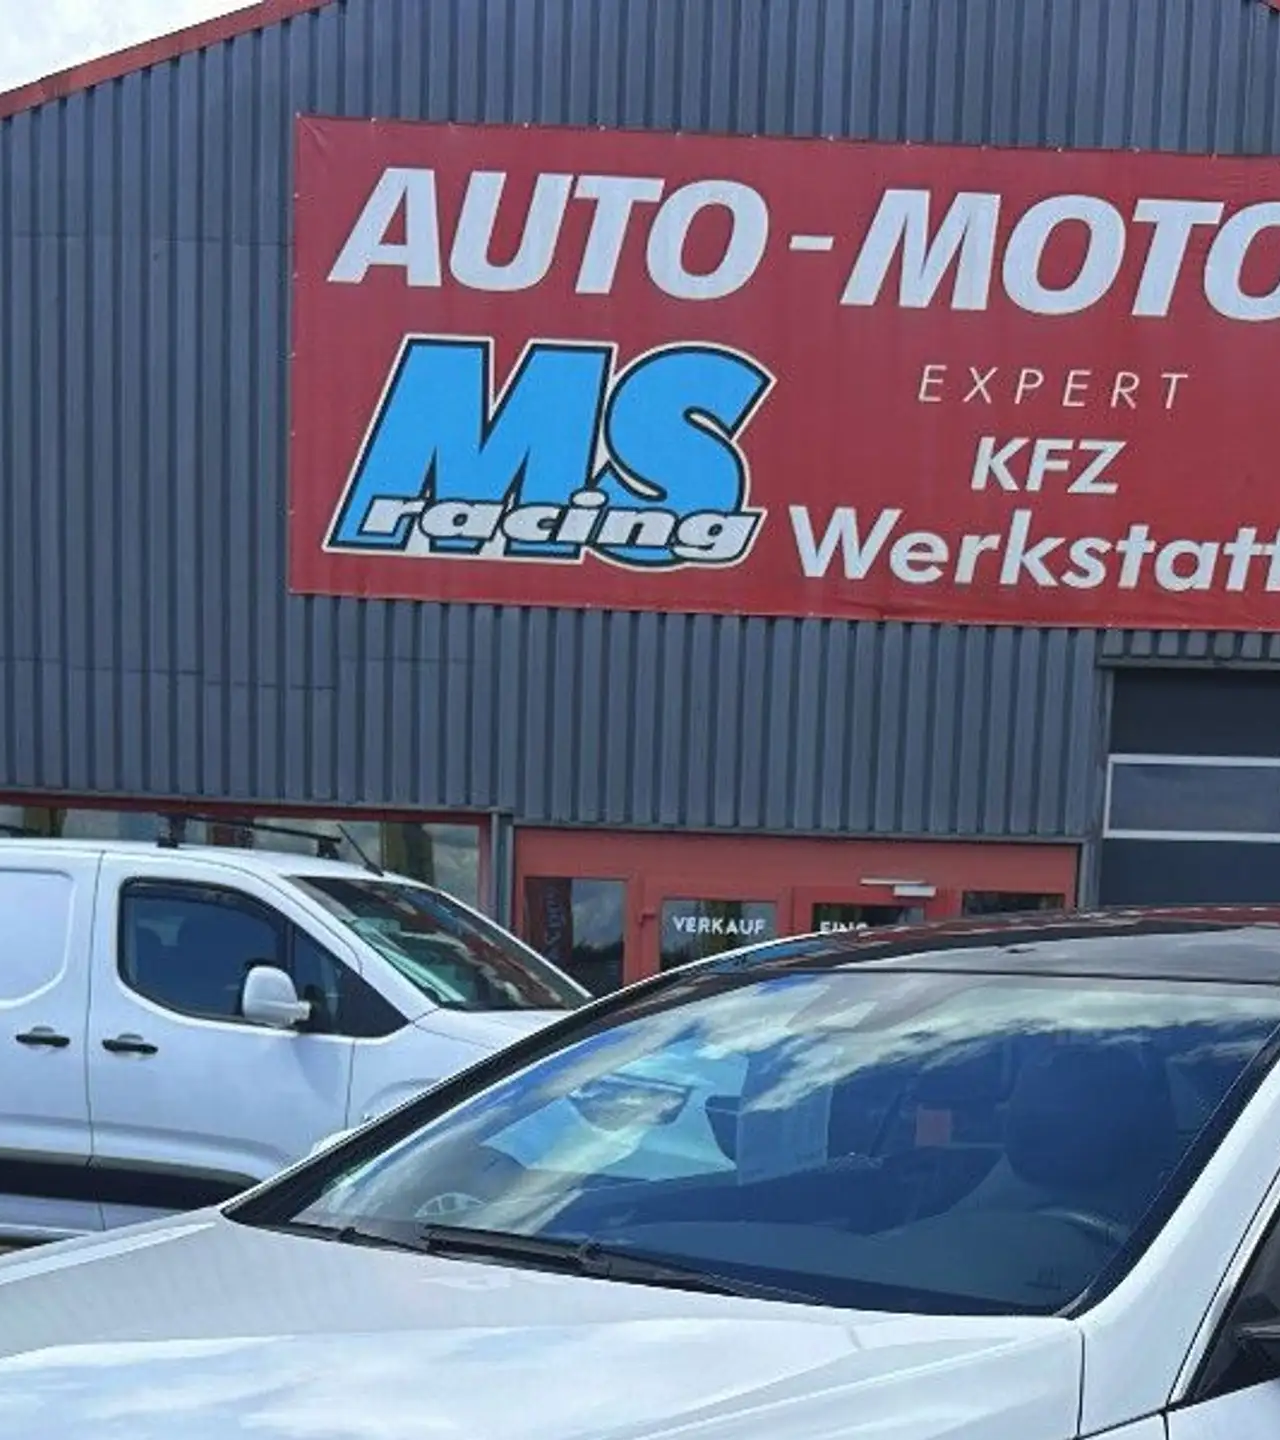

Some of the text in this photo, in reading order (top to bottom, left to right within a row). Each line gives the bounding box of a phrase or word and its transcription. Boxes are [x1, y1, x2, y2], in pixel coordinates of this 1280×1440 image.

[917, 363, 1191, 412] EXPERT
[324, 335, 776, 568] MS
[970, 436, 1127, 497] KFZ
[359, 489, 765, 563] racing
[672, 915, 767, 935] VERKAUF
